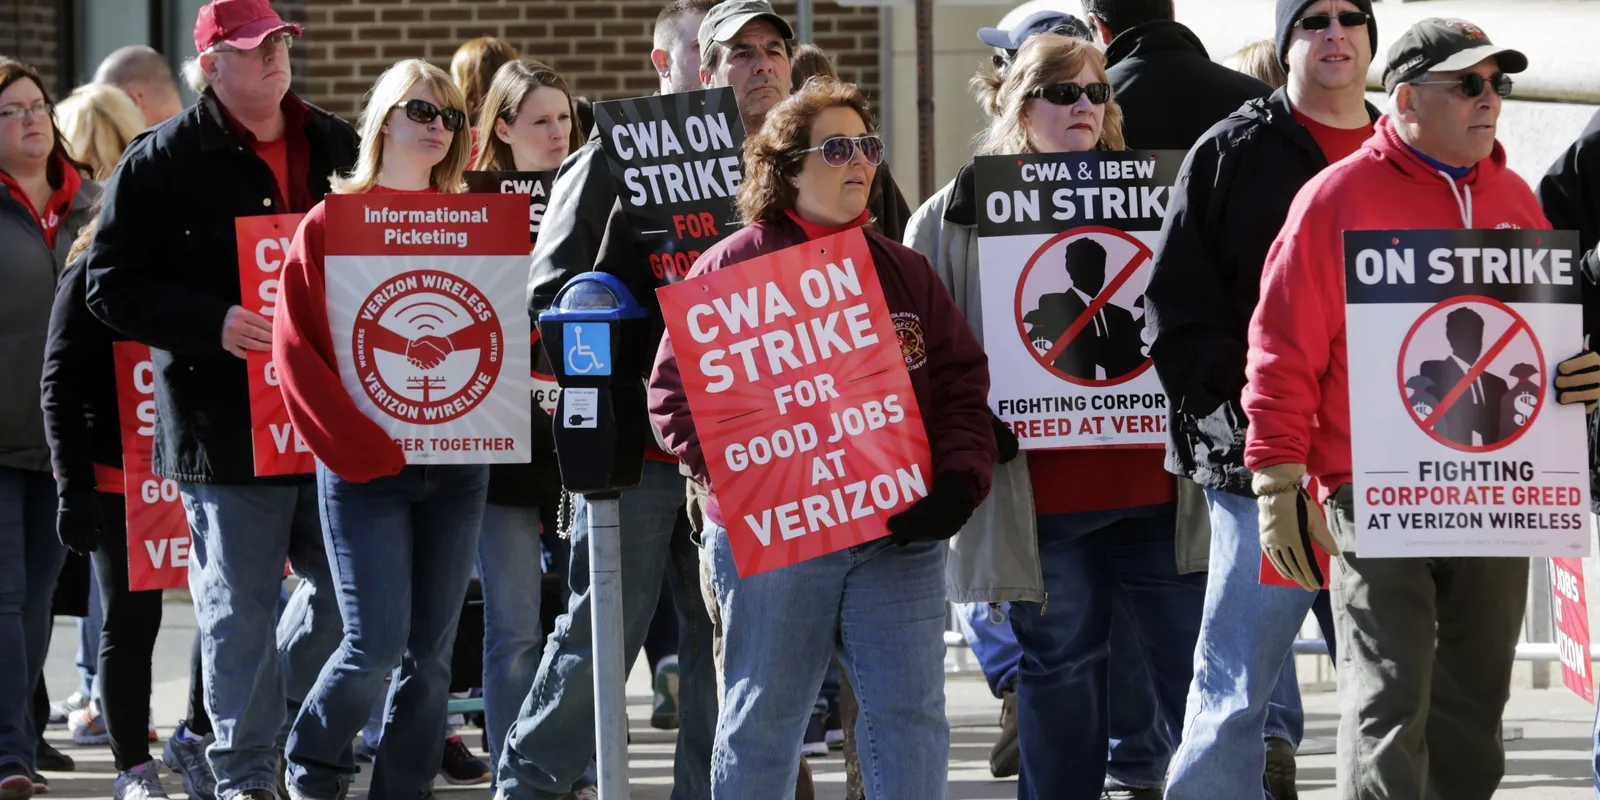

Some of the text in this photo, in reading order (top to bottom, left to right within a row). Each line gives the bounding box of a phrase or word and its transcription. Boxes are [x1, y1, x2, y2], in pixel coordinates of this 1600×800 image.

[612, 112, 734, 161] CWA ON
[624, 156, 742, 207] STRIKE
[1021, 160, 1156, 182] CWA & IBEW
[500, 180, 546, 197] CWA
[364, 207, 488, 223] Informational
[986, 190, 1040, 224] ON
[384, 228, 468, 248] Picketing
[672, 212, 719, 240] FOR
[1355, 247, 1573, 285] ON STRIKE
[361, 275, 492, 322] VERIZON WIRELESS
[686, 257, 863, 343] CWA ON
[357, 328, 366, 369] WORKERS
[489, 331, 497, 363] UNITED
[700, 303, 879, 393] STRIKE
[364, 371, 492, 420] VERIZON WIRELINE
[773, 373, 840, 415] FOR
[998, 396, 1086, 415] FIGHTING
[724, 394, 905, 472] GOOD JOBS
[1078, 416, 1105, 435] AT
[430, 438, 514, 450] TOGETHER
[811, 448, 846, 486] AT
[1419, 461, 1534, 482] FIGHTING
[744, 463, 929, 547] VERIZON
[1366, 486, 1581, 506] CORPORATE GREED
[1367, 512, 1582, 530] AT VERIZON WIRELESS
